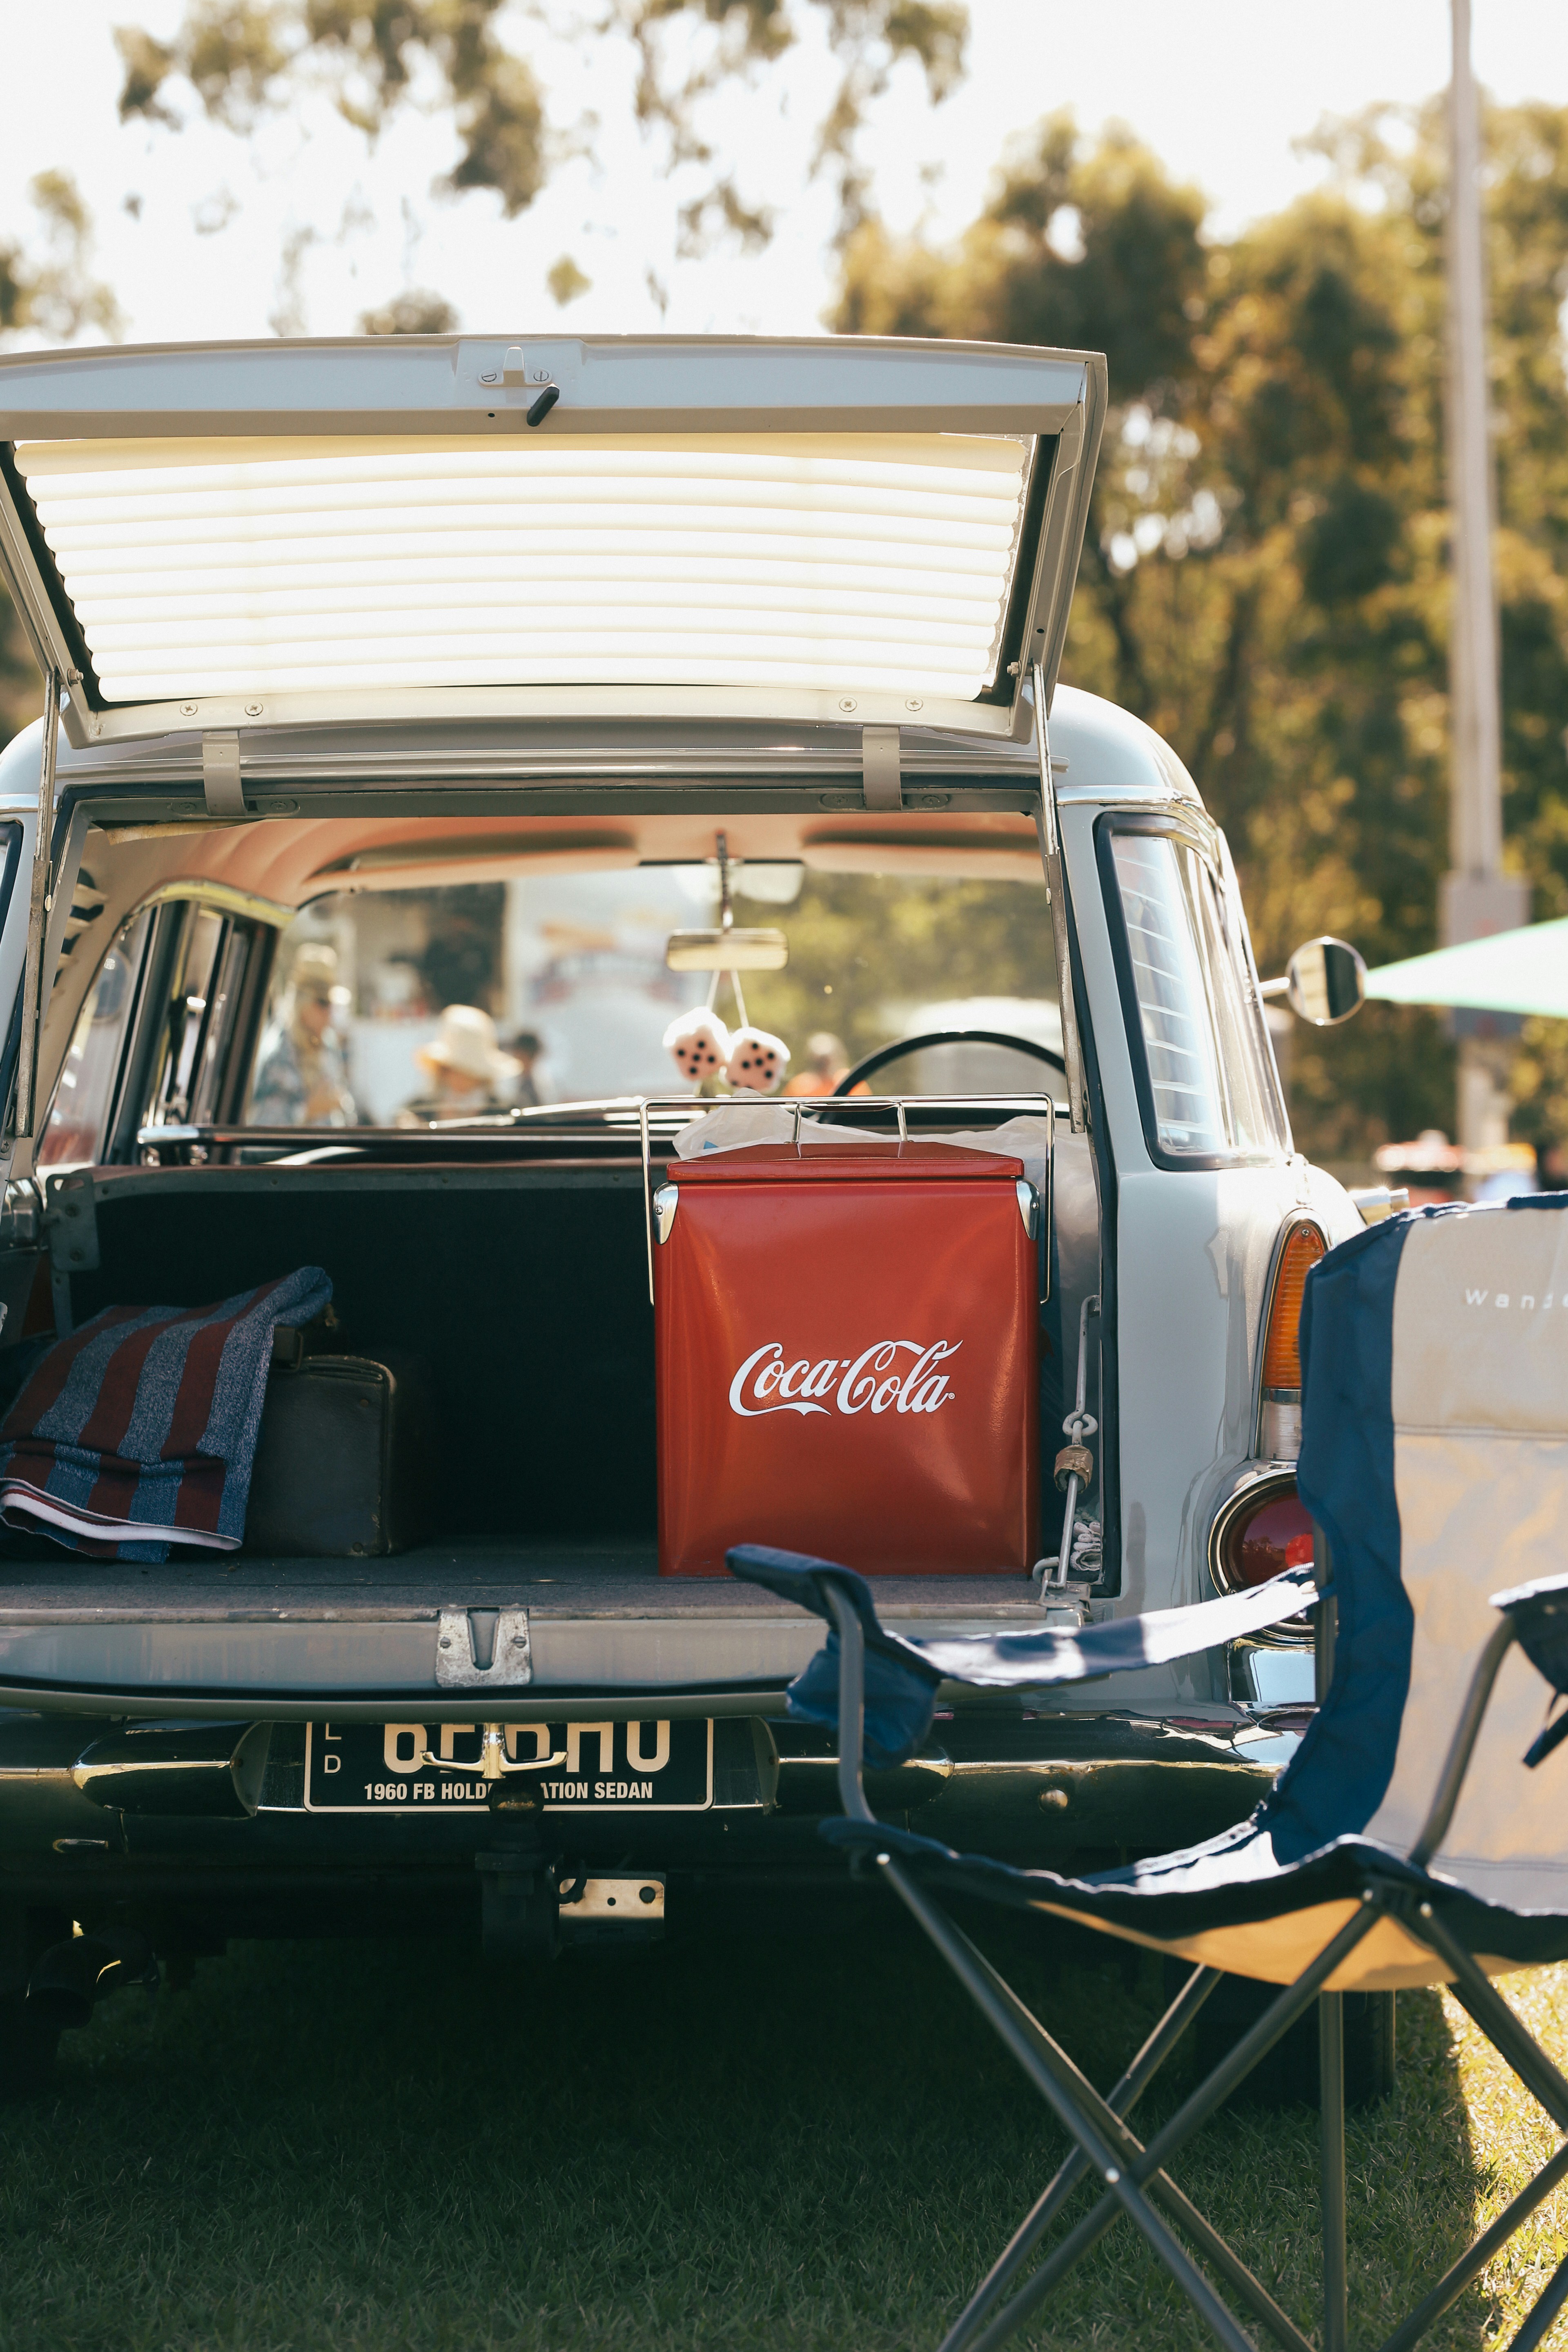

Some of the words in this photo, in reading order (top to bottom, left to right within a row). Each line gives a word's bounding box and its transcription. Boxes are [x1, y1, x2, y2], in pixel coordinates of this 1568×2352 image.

[729, 1340, 963, 1416] Coca-Cola
[364, 1783, 408, 1800] 1960
[413, 1783, 435, 1800] FB
[441, 1783, 493, 1800] HOLD
[595, 1782, 653, 1799] SEDAN
